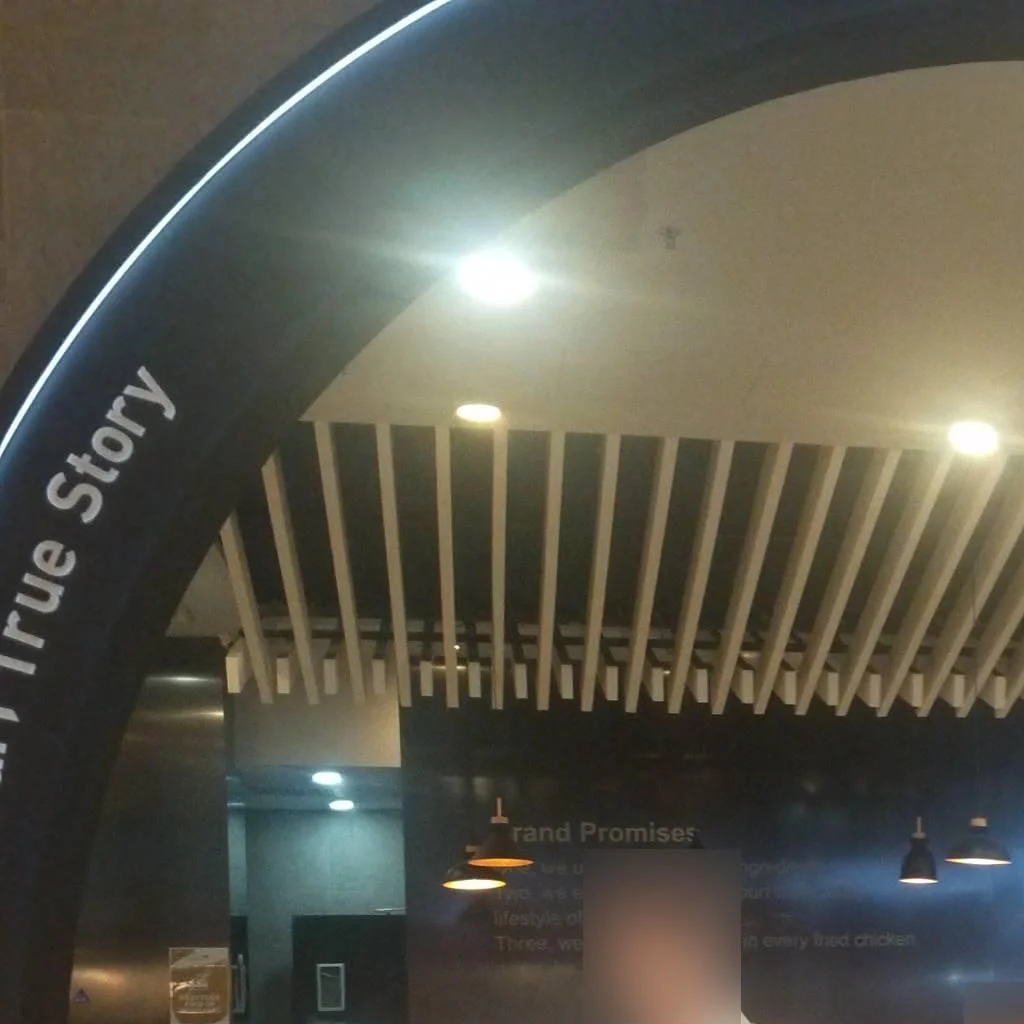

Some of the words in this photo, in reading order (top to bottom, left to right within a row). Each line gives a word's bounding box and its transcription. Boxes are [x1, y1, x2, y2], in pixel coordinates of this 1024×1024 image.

[46, 366, 177, 524] Story
[511, 821, 571, 844] rand
[579, 821, 698, 844] Promises
